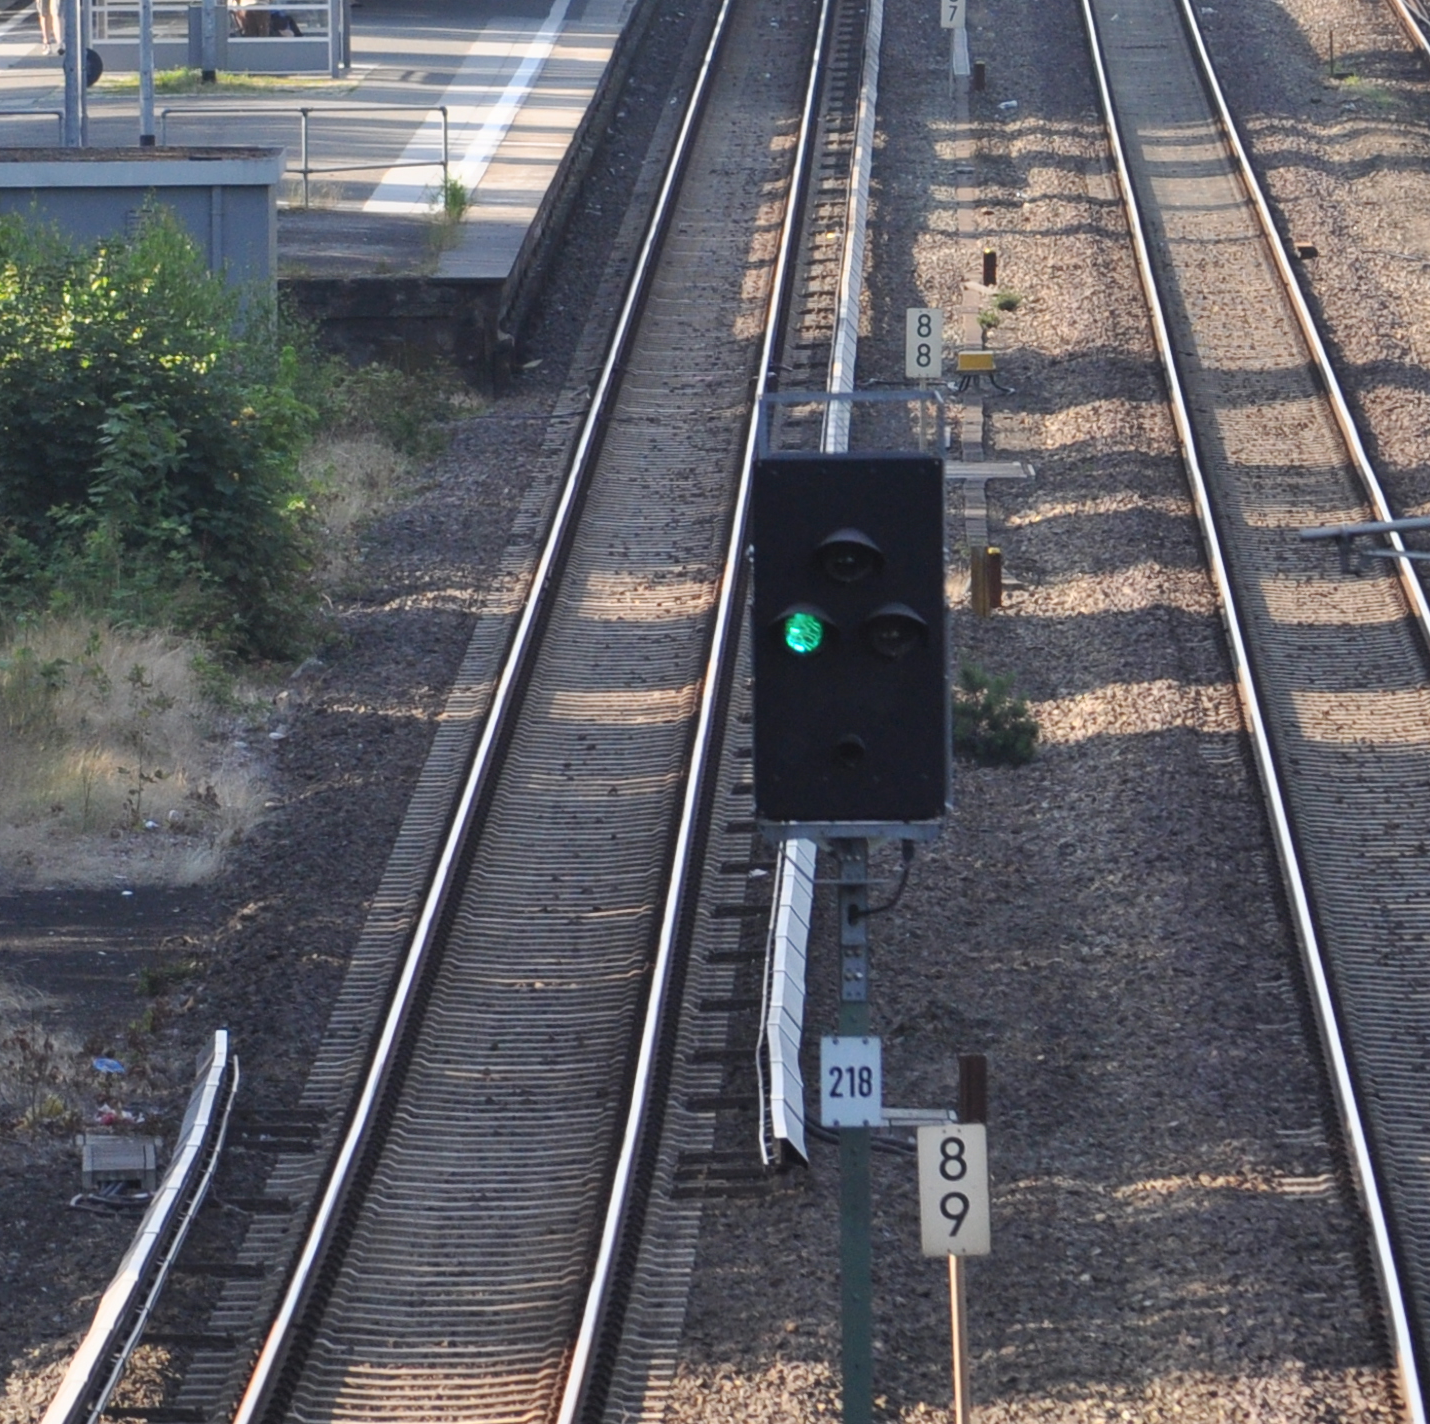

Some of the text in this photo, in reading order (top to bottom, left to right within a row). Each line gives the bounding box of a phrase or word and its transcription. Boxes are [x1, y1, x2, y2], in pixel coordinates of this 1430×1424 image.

[948, 5, 958, 22] 7
[917, 313, 932, 338] 8
[916, 343, 931, 368] 8
[828, 1065, 873, 1098] 218
[939, 1136, 967, 1181] 8
[939, 1191, 970, 1237] 9
